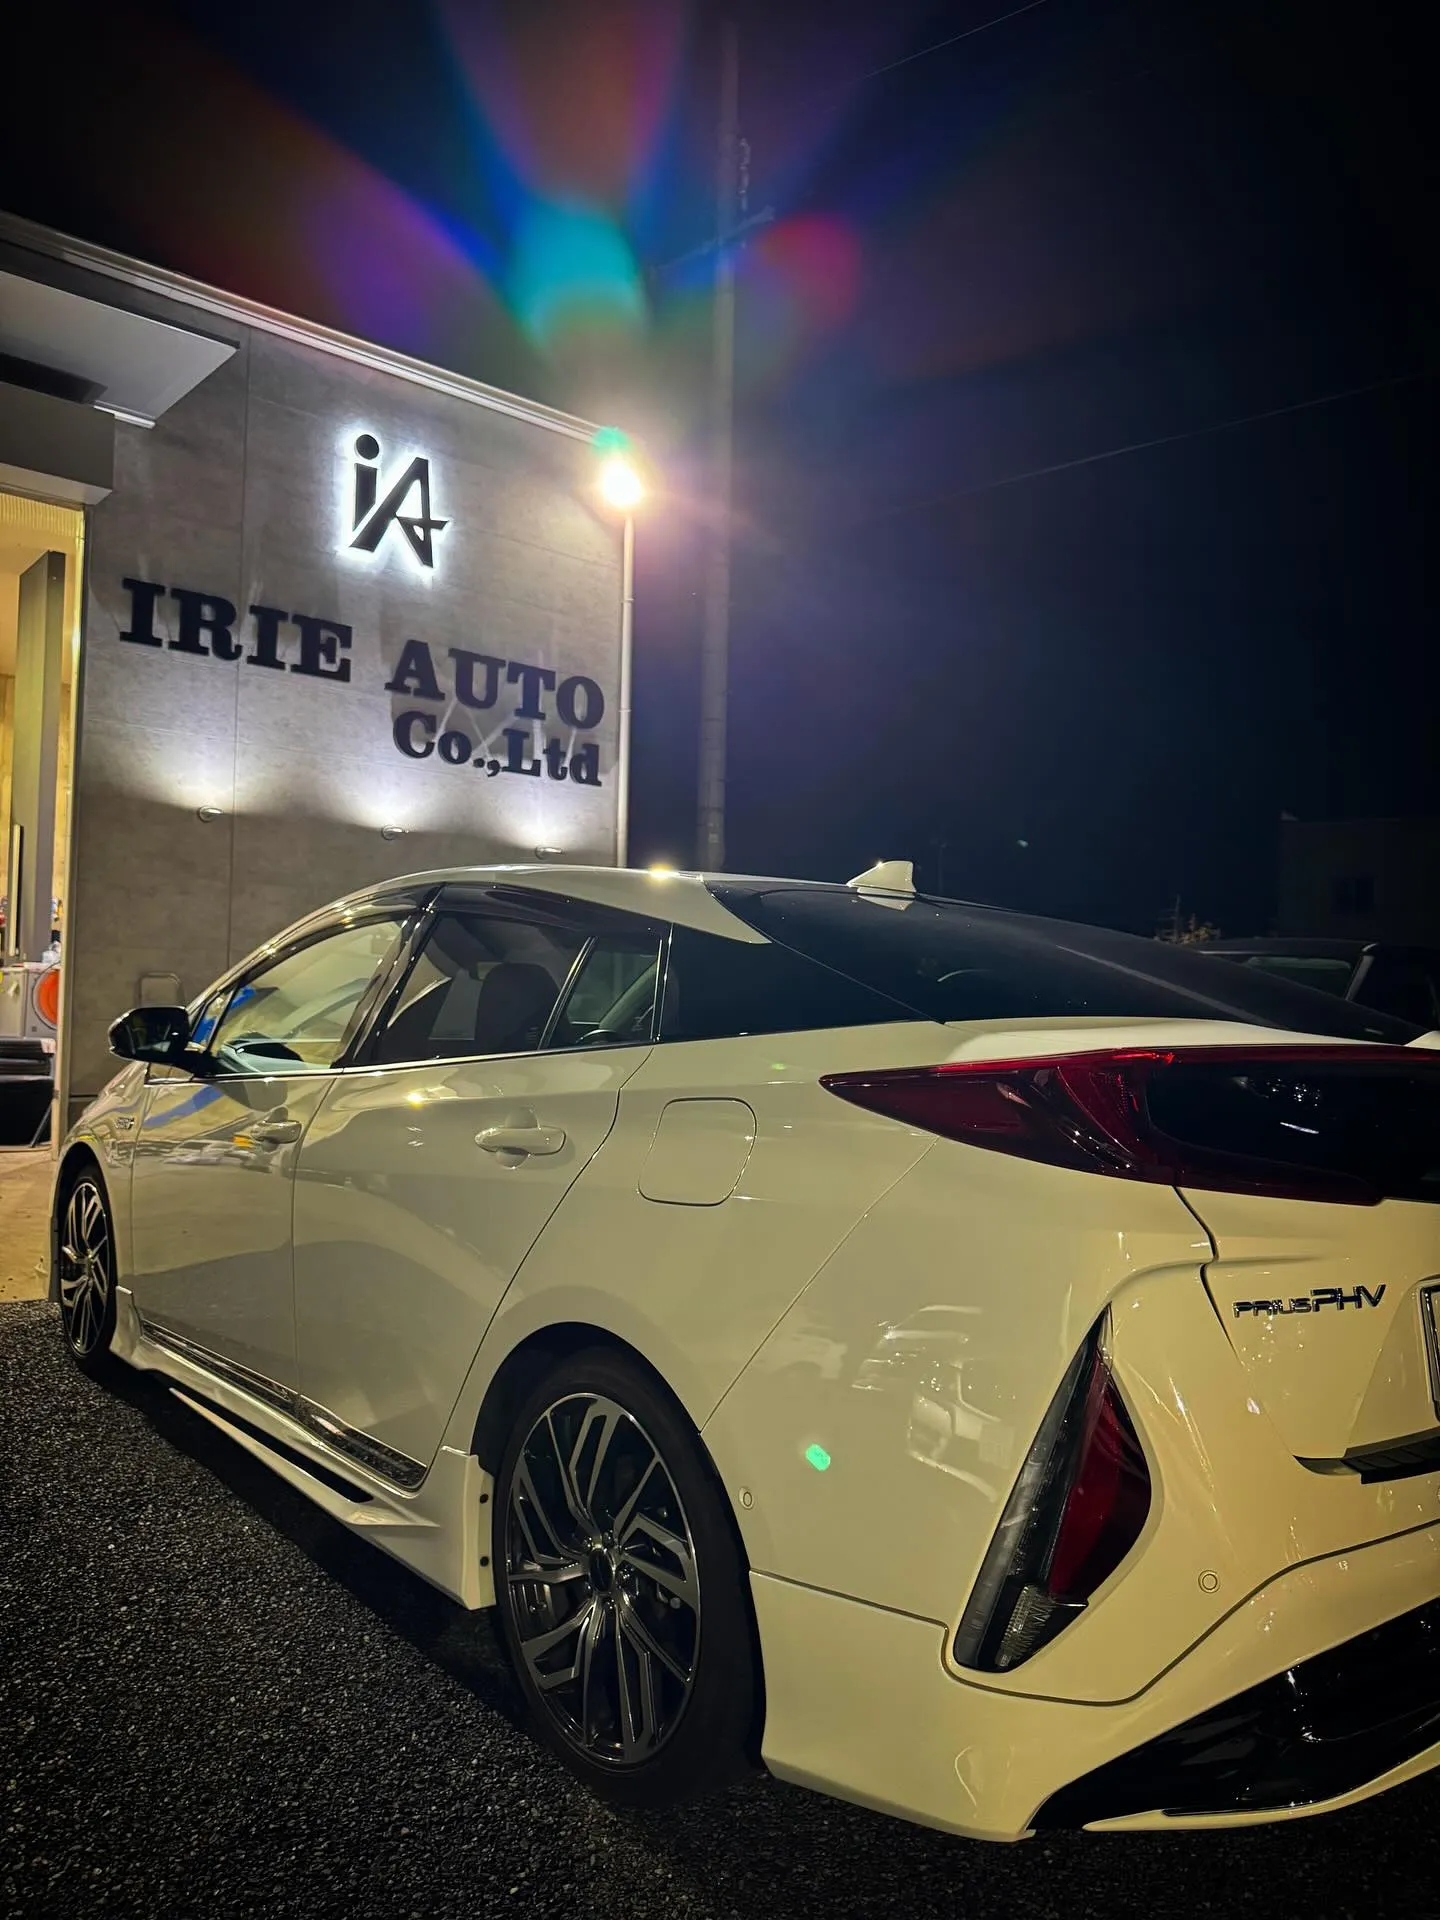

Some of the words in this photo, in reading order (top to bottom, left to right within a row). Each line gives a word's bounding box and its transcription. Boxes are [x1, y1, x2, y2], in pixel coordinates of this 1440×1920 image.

[119, 577, 353, 683] IRIE
[384, 639, 605, 730] AUTO
[393, 711, 602, 787] Co.,Ltd
